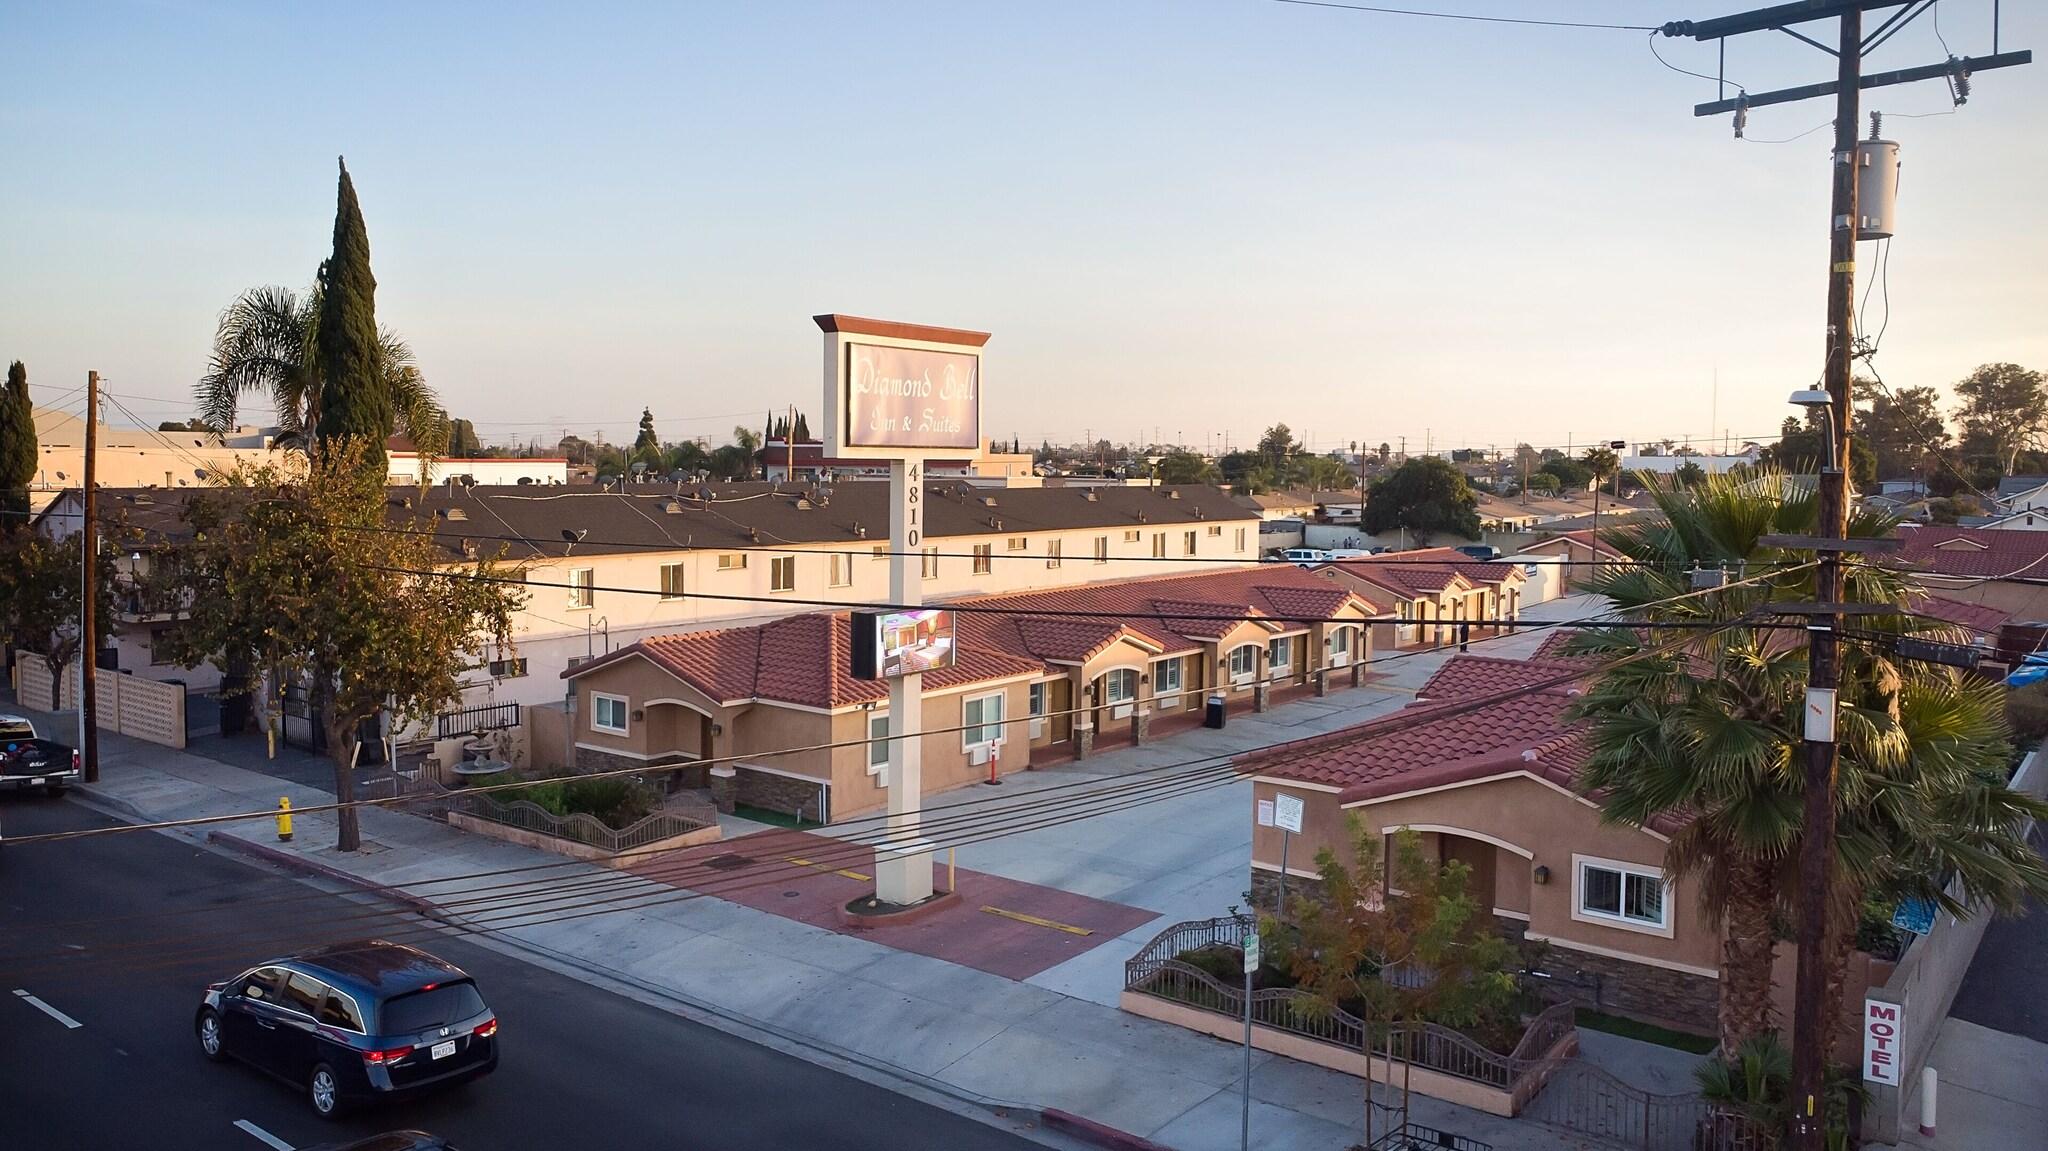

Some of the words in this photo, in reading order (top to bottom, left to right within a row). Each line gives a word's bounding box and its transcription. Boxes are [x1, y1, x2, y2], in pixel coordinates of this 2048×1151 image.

[858, 358, 932, 398] Diamond
[940, 363, 977, 401] Bell
[870, 406, 896, 431] Inn
[902, 415, 912, 432] &
[919, 408, 961, 433] Suites
[908, 463, 920, 547] 4810
[1870, 1005, 1896, 1080] MOTEL
